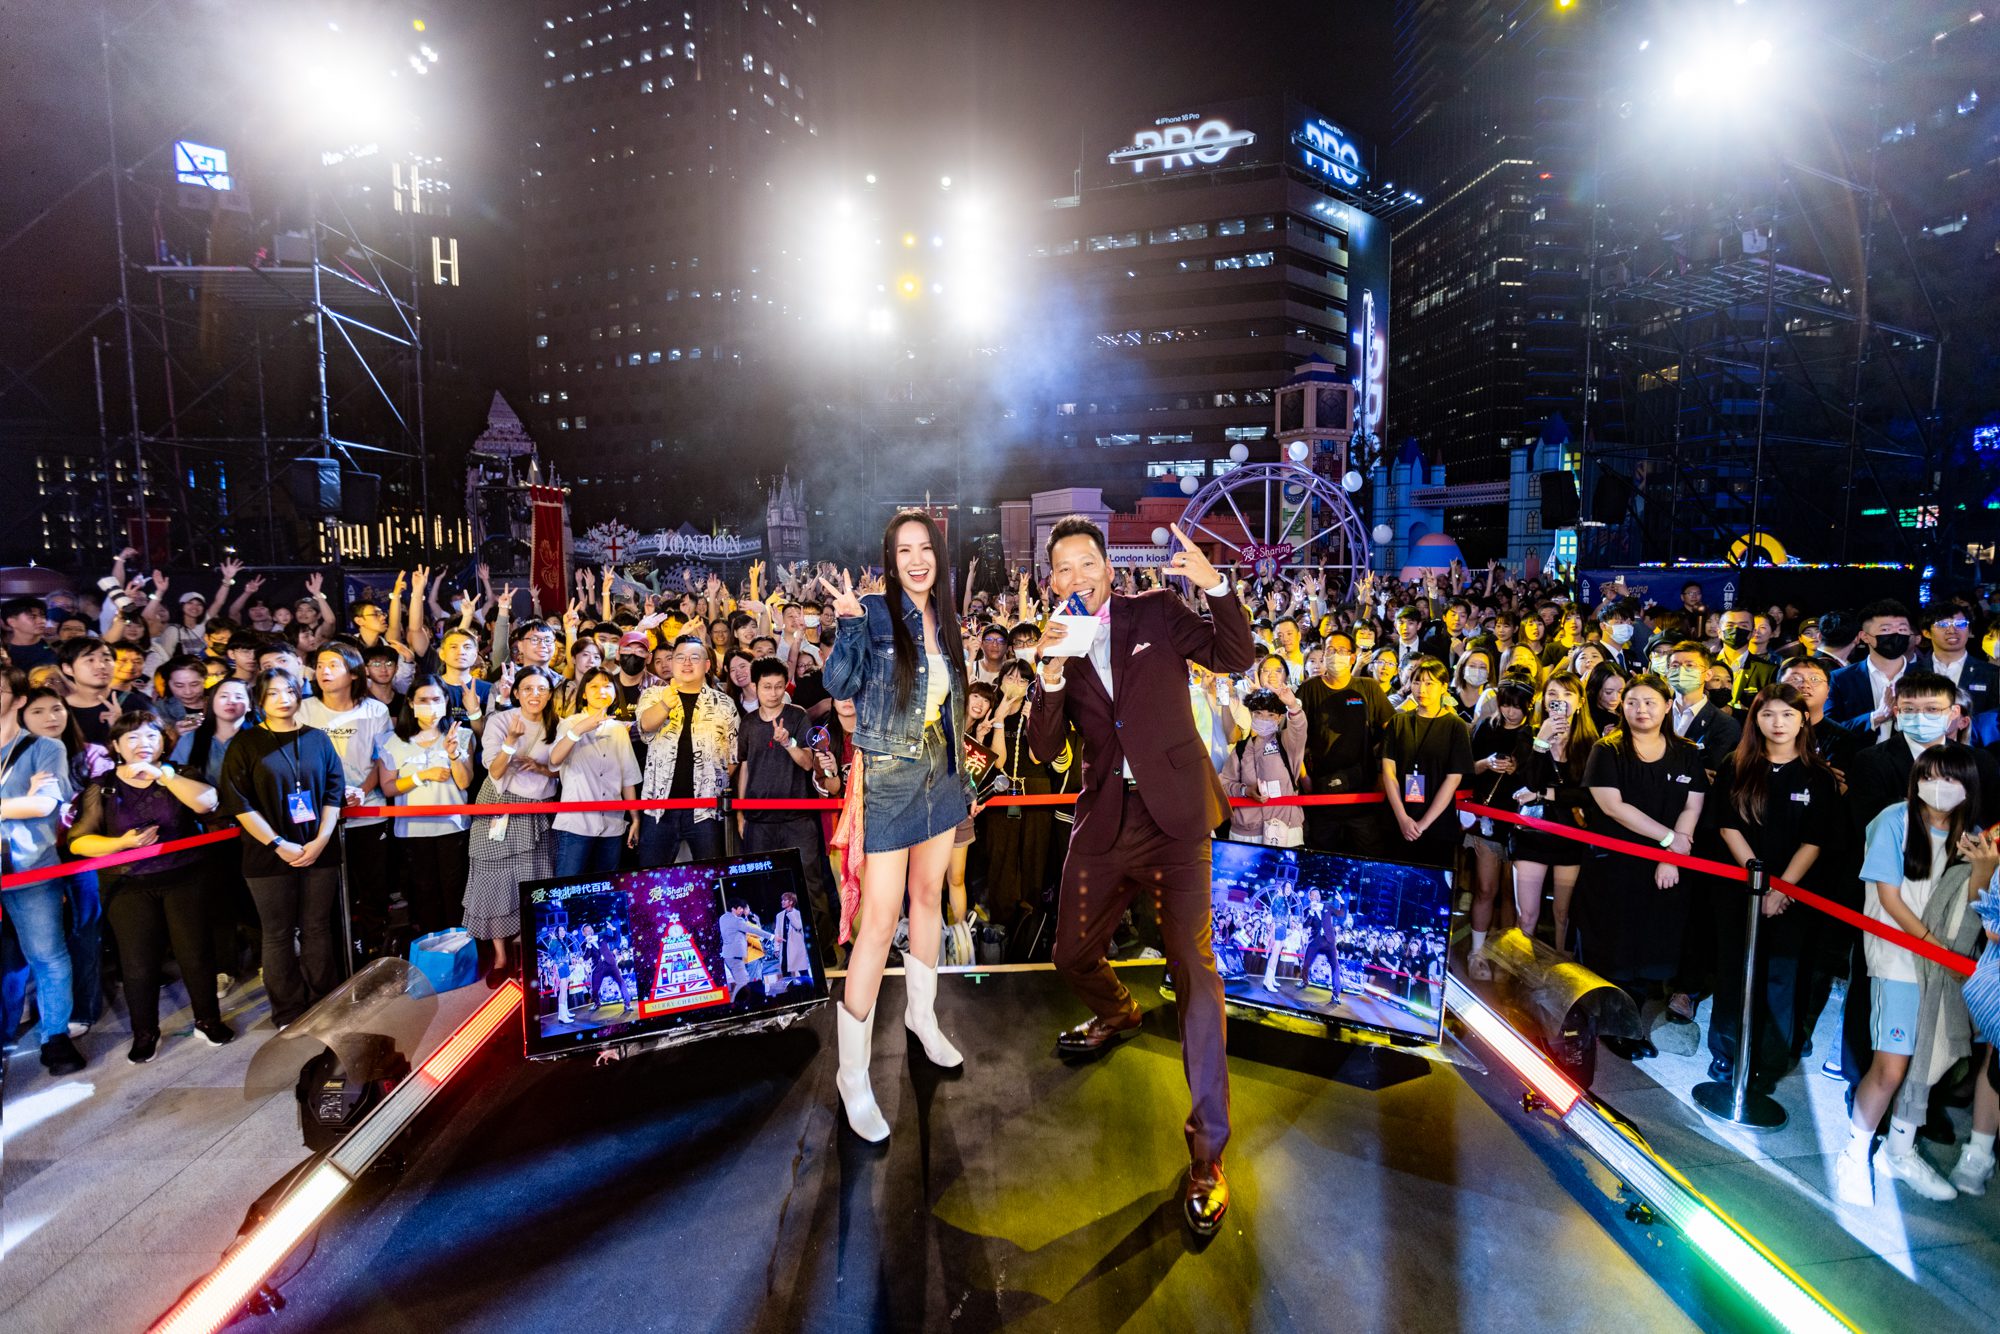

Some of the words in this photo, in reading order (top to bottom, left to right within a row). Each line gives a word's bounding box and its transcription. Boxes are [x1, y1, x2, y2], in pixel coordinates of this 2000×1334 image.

[1160, 116, 1181, 125] iPhone
[1181, 114, 1189, 122] 16
[1189, 113, 1200, 121] Pro
[1134, 120, 1232, 173] PRO
[1306, 123, 1360, 185] PRO
[656, 529, 741, 560] LONDON
[1109, 554, 1144, 562] London
[1146, 554, 1170, 562] kiosk
[728, 860, 773, 875] 高雄夢時代
[651, 1001, 675, 1010] MERRY
[677, 993, 718, 1005] CHRISTMAS
